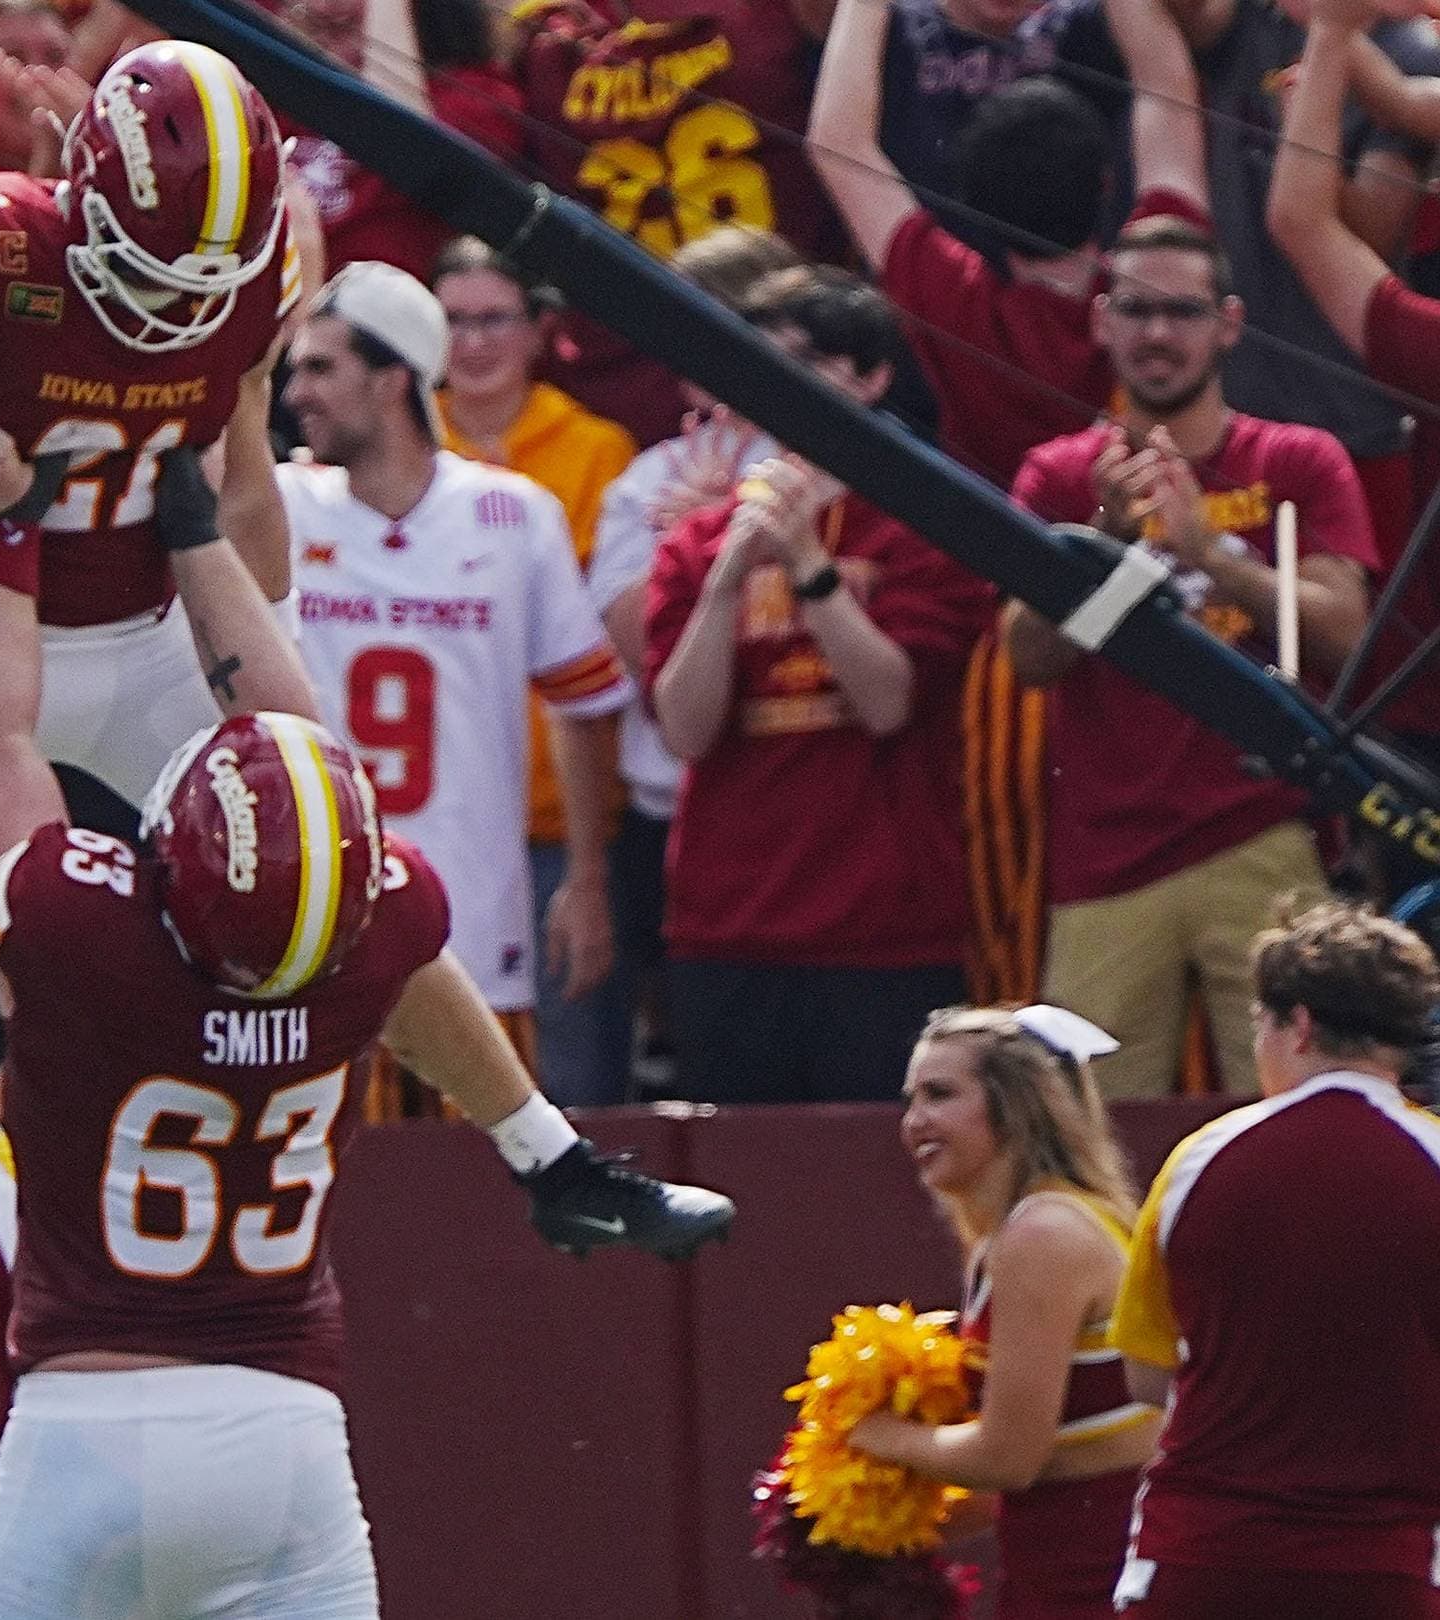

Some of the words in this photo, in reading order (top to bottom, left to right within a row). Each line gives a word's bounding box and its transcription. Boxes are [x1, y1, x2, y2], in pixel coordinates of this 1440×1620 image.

[39, 373, 117, 408] IOWA
[122, 375, 209, 411] STATE
[33, 413, 189, 532] 21
[344, 643, 438, 817] 9
[206, 747, 258, 892] Cyclones
[203, 1006, 309, 1066] SMITH
[99, 1058, 350, 1280] 63
